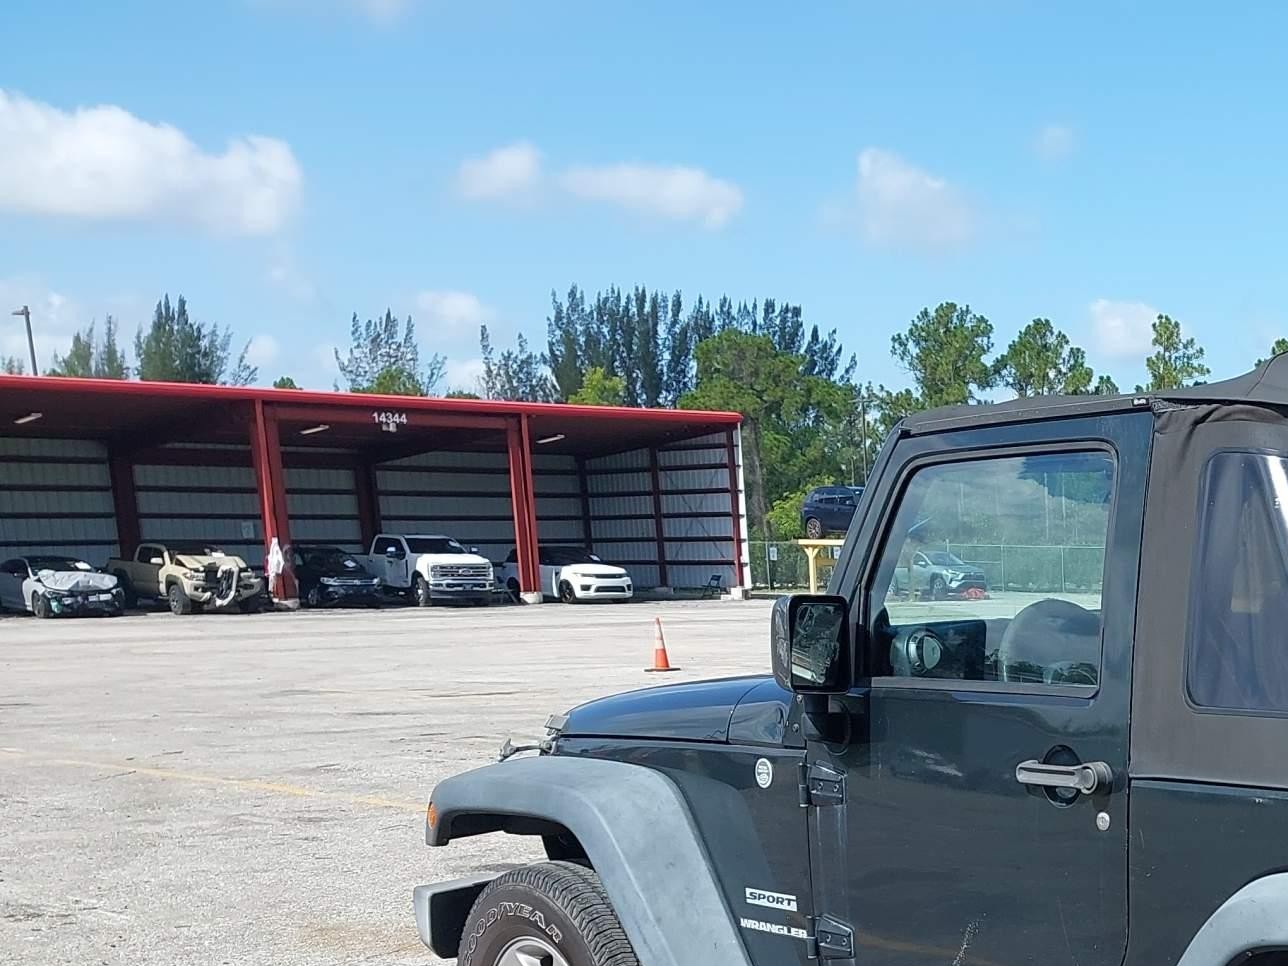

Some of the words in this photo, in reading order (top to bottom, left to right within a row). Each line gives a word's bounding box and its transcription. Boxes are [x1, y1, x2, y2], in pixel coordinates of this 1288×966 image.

[371, 411, 408, 425] 14344
[745, 891, 797, 907] SPORT
[740, 917, 809, 939] WRANGLER
